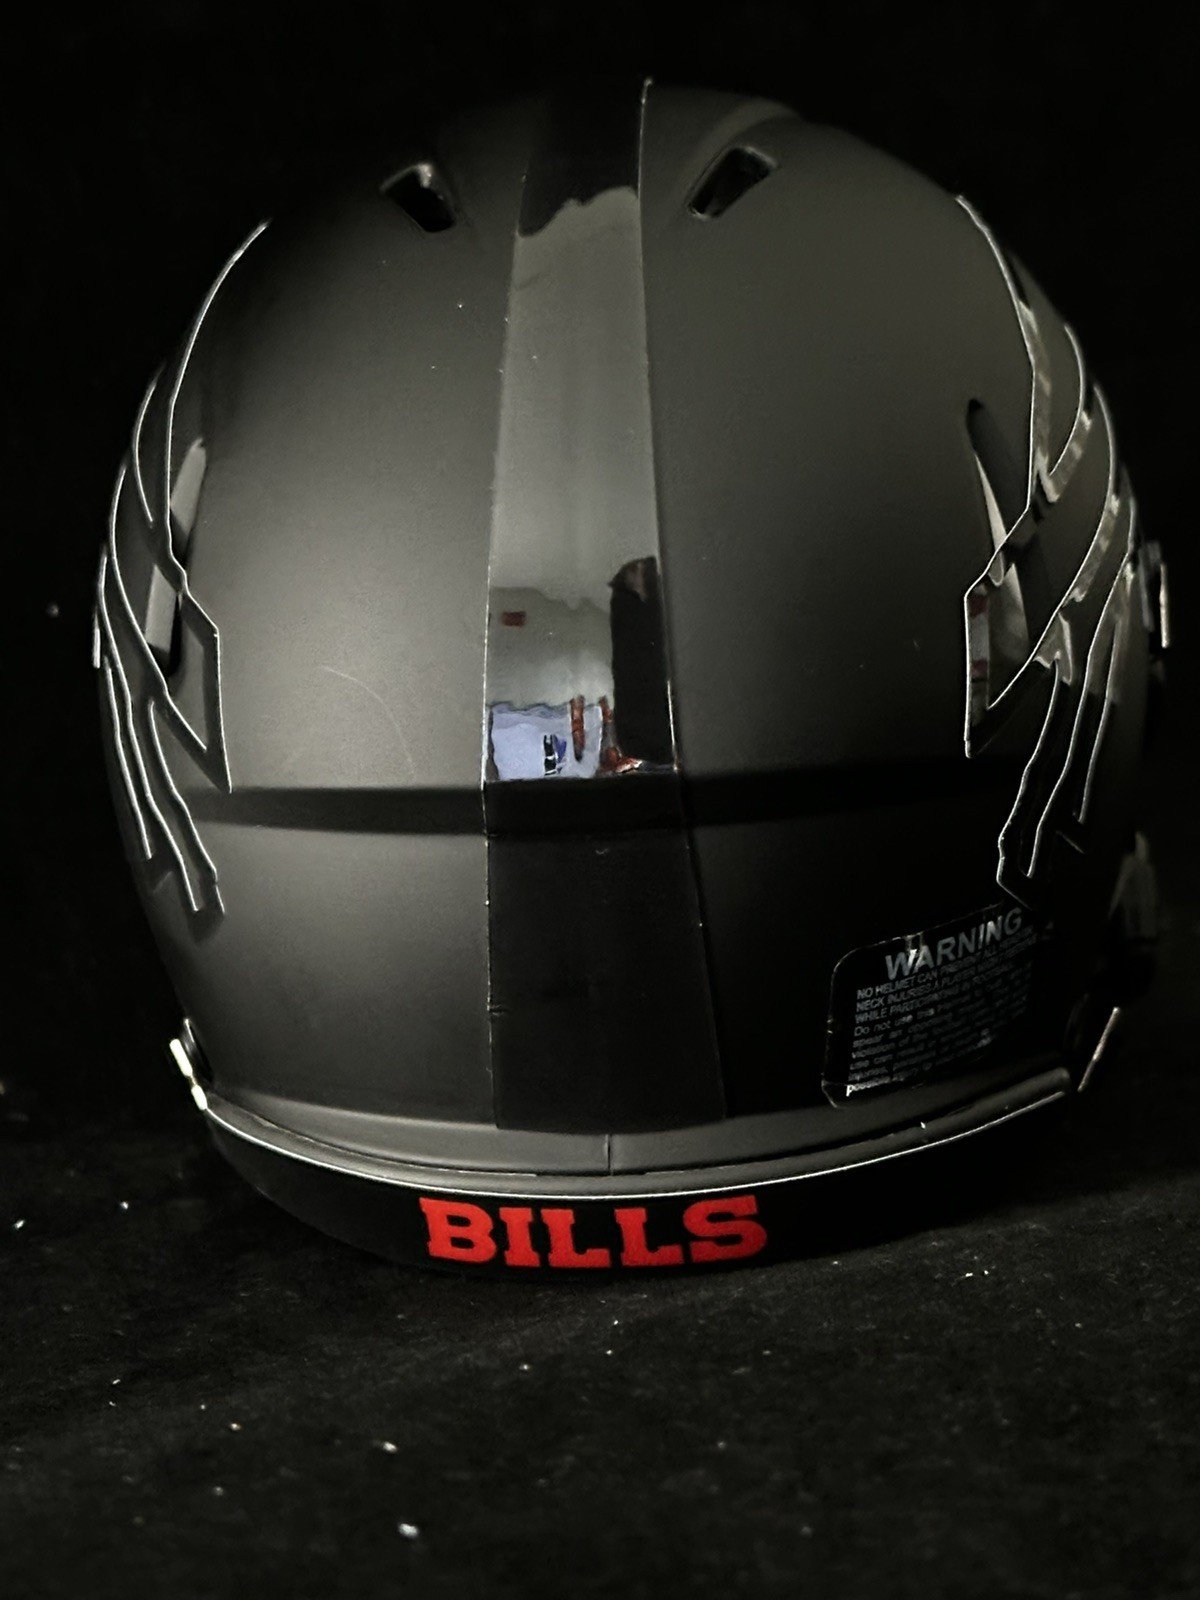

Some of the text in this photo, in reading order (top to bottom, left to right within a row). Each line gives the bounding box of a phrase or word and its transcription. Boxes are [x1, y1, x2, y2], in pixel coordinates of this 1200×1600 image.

[885, 907, 1022, 980] WARNING
[857, 988, 873, 1000] NO
[876, 976, 915, 995] HELMET
[856, 997, 884, 1013] NECK
[855, 1009, 887, 1024] WHILE
[854, 1025, 870, 1037] Do
[419, 1195, 768, 1269] BILLS
